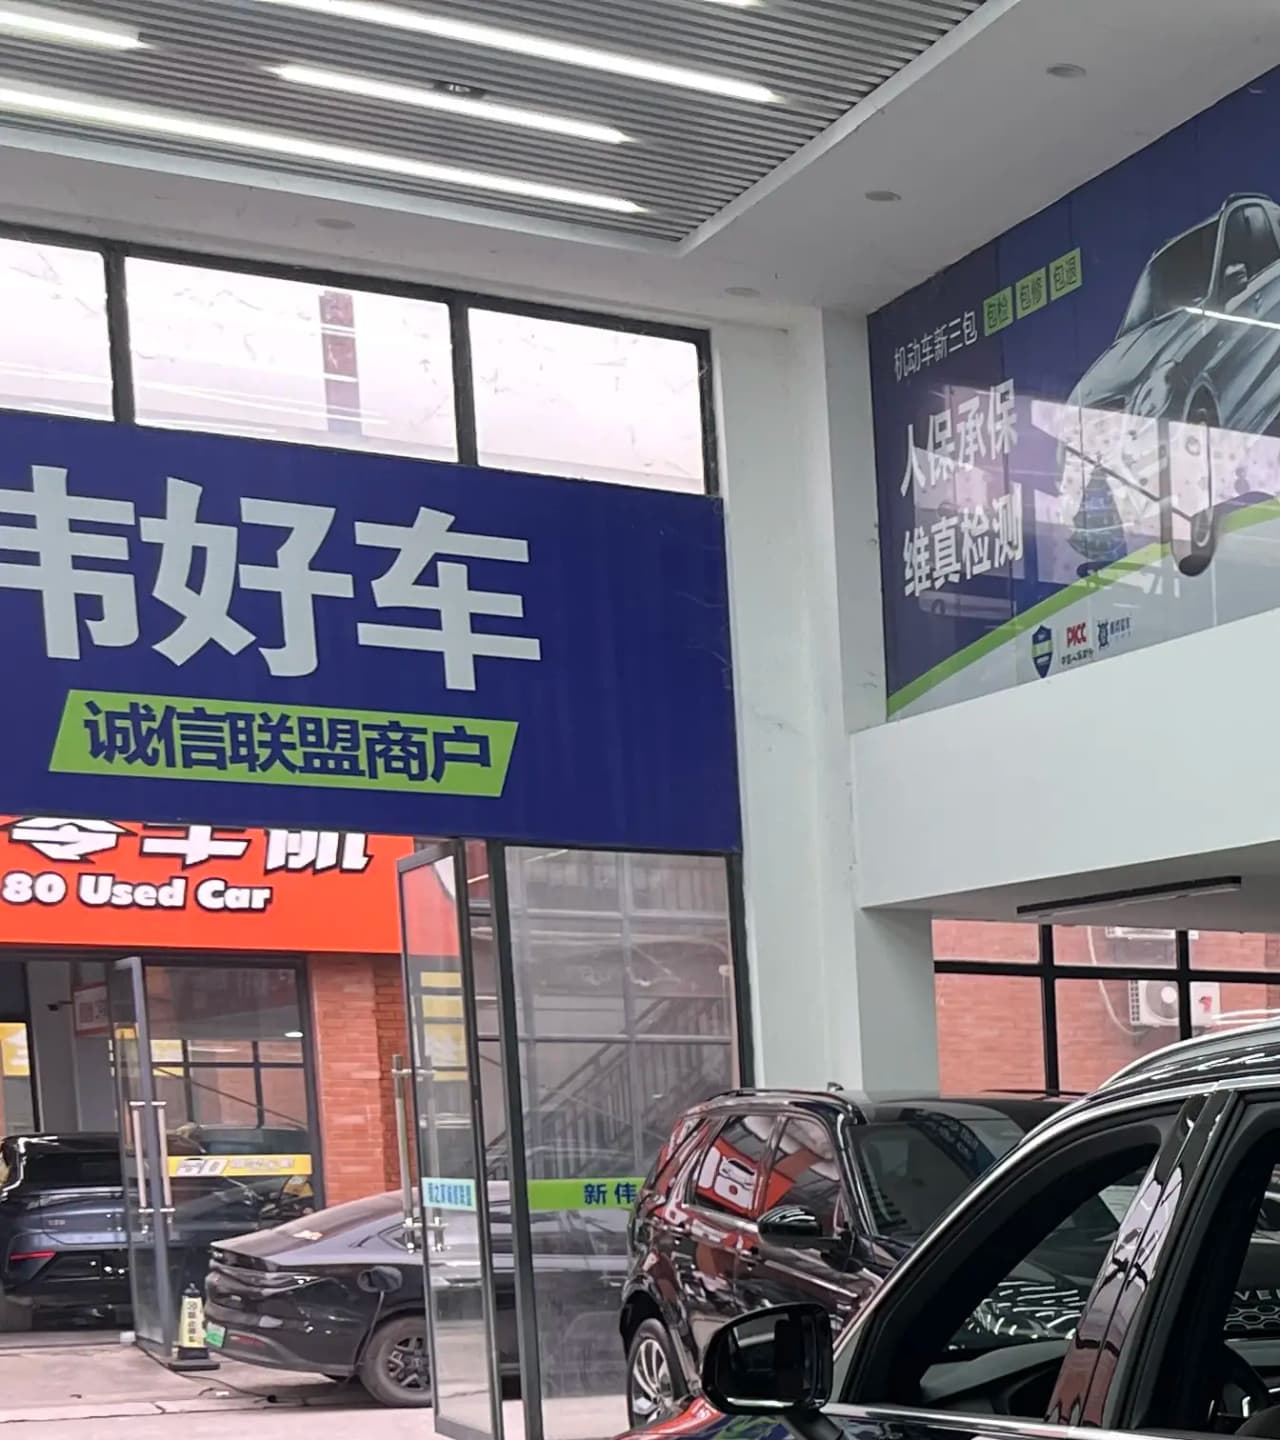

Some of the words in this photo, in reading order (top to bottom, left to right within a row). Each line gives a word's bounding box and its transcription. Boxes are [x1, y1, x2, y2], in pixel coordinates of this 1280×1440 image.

[894, 311, 978, 382] 机动车新三包
[901, 378, 1018, 497] 人保承保
[903, 481, 1024, 598] 维真检测
[1066, 622, 1087, 648] PICC
[84, 701, 492, 784] 诚信联盟商户
[2, 871, 67, 904] 80
[77, 873, 187, 908] Used
[196, 879, 272, 911] Car
[584, 1182, 637, 1205] 新伟
